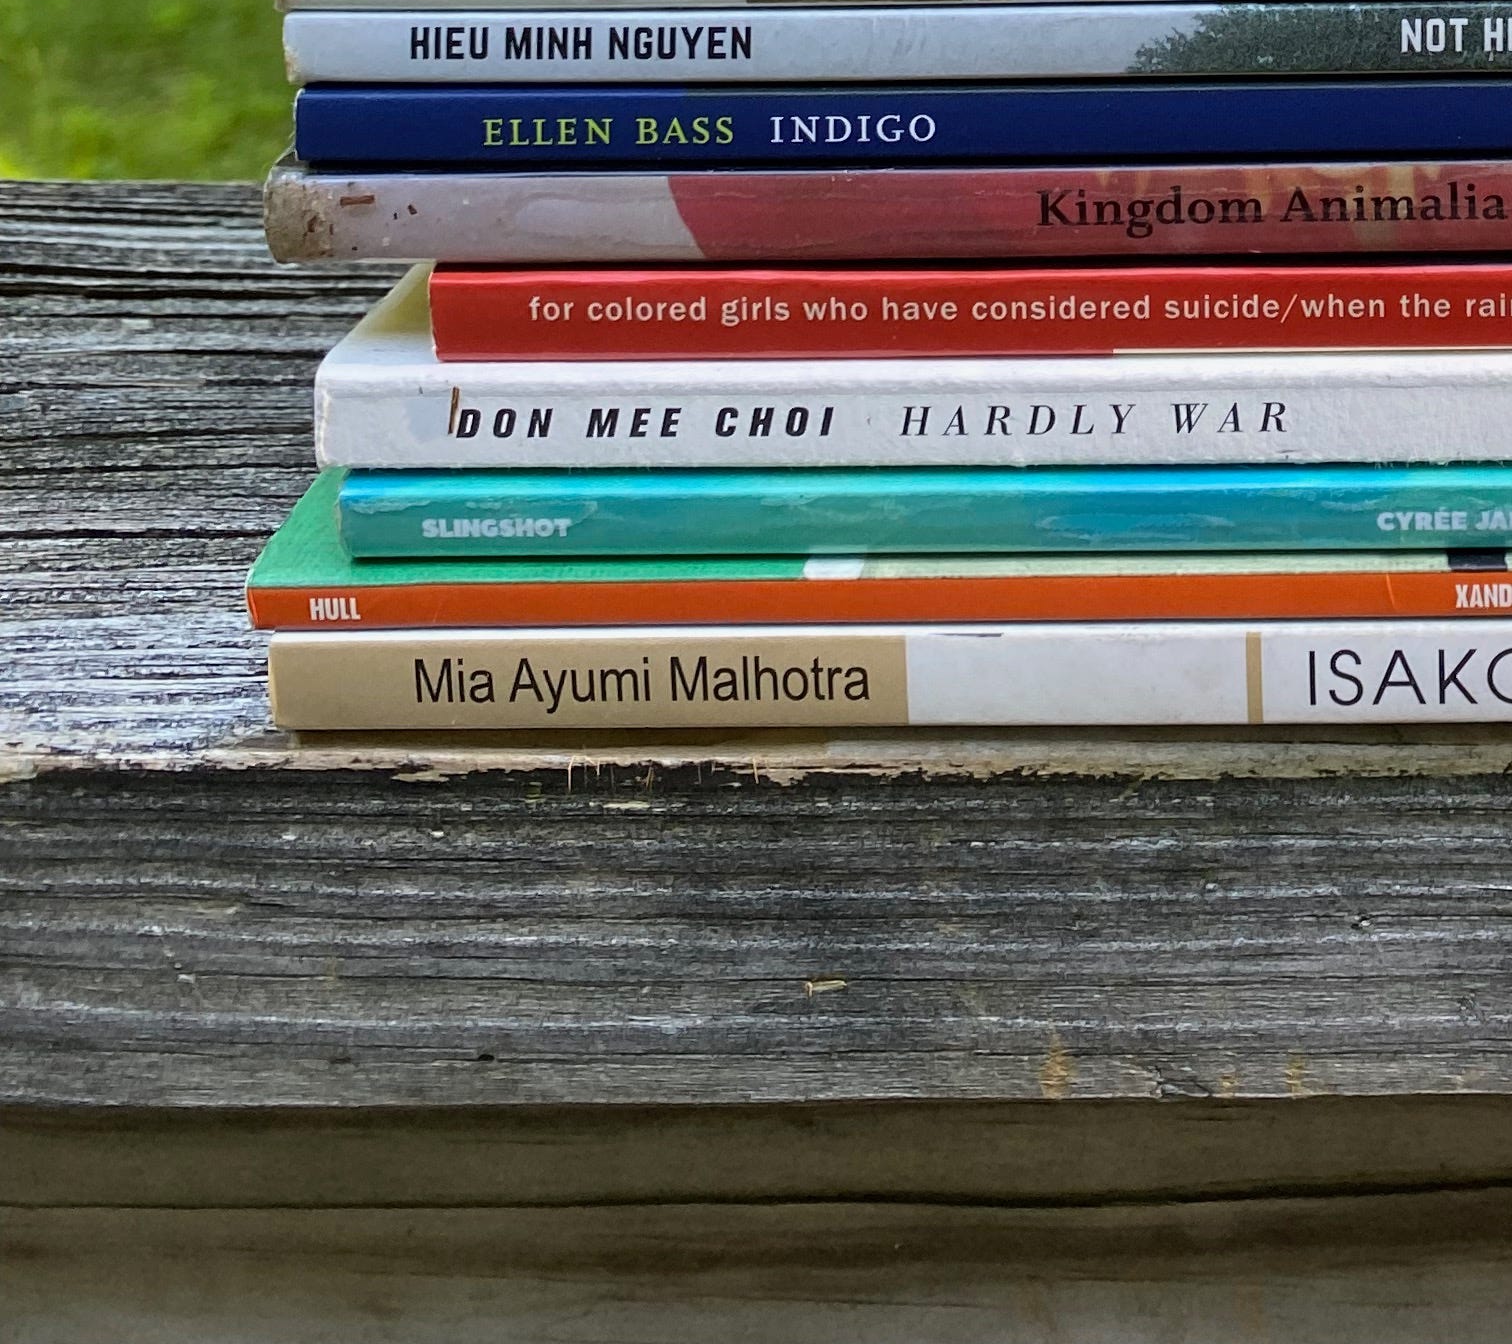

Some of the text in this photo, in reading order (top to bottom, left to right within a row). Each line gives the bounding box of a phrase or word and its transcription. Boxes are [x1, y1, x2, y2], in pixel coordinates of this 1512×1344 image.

[410, 26, 752, 60] HIEU MINH NGUYEN
[1401, 19, 1463, 52] NOT
[484, 115, 936, 146] ELLEN BASS INDIGO
[1036, 184, 1507, 239] Kingdom Animalia
[529, 296, 575, 322] for
[588, 295, 707, 321] colored
[721, 295, 790, 327] girls
[802, 295, 868, 321] who
[881, 295, 957, 321] have
[970, 293, 1151, 320] considered
[1164, 292, 1386, 324] suicide/when
[1400, 292, 1451, 318] the
[455, 408, 833, 438] DON MEE CHOI
[898, 401, 1288, 436] HARDLY WAR
[421, 517, 571, 538] SLINGSHOT
[1377, 506, 1468, 531] CYRÉE
[309, 598, 360, 621] HULL
[414, 655, 870, 711] Mia Ayumi Malhotra
